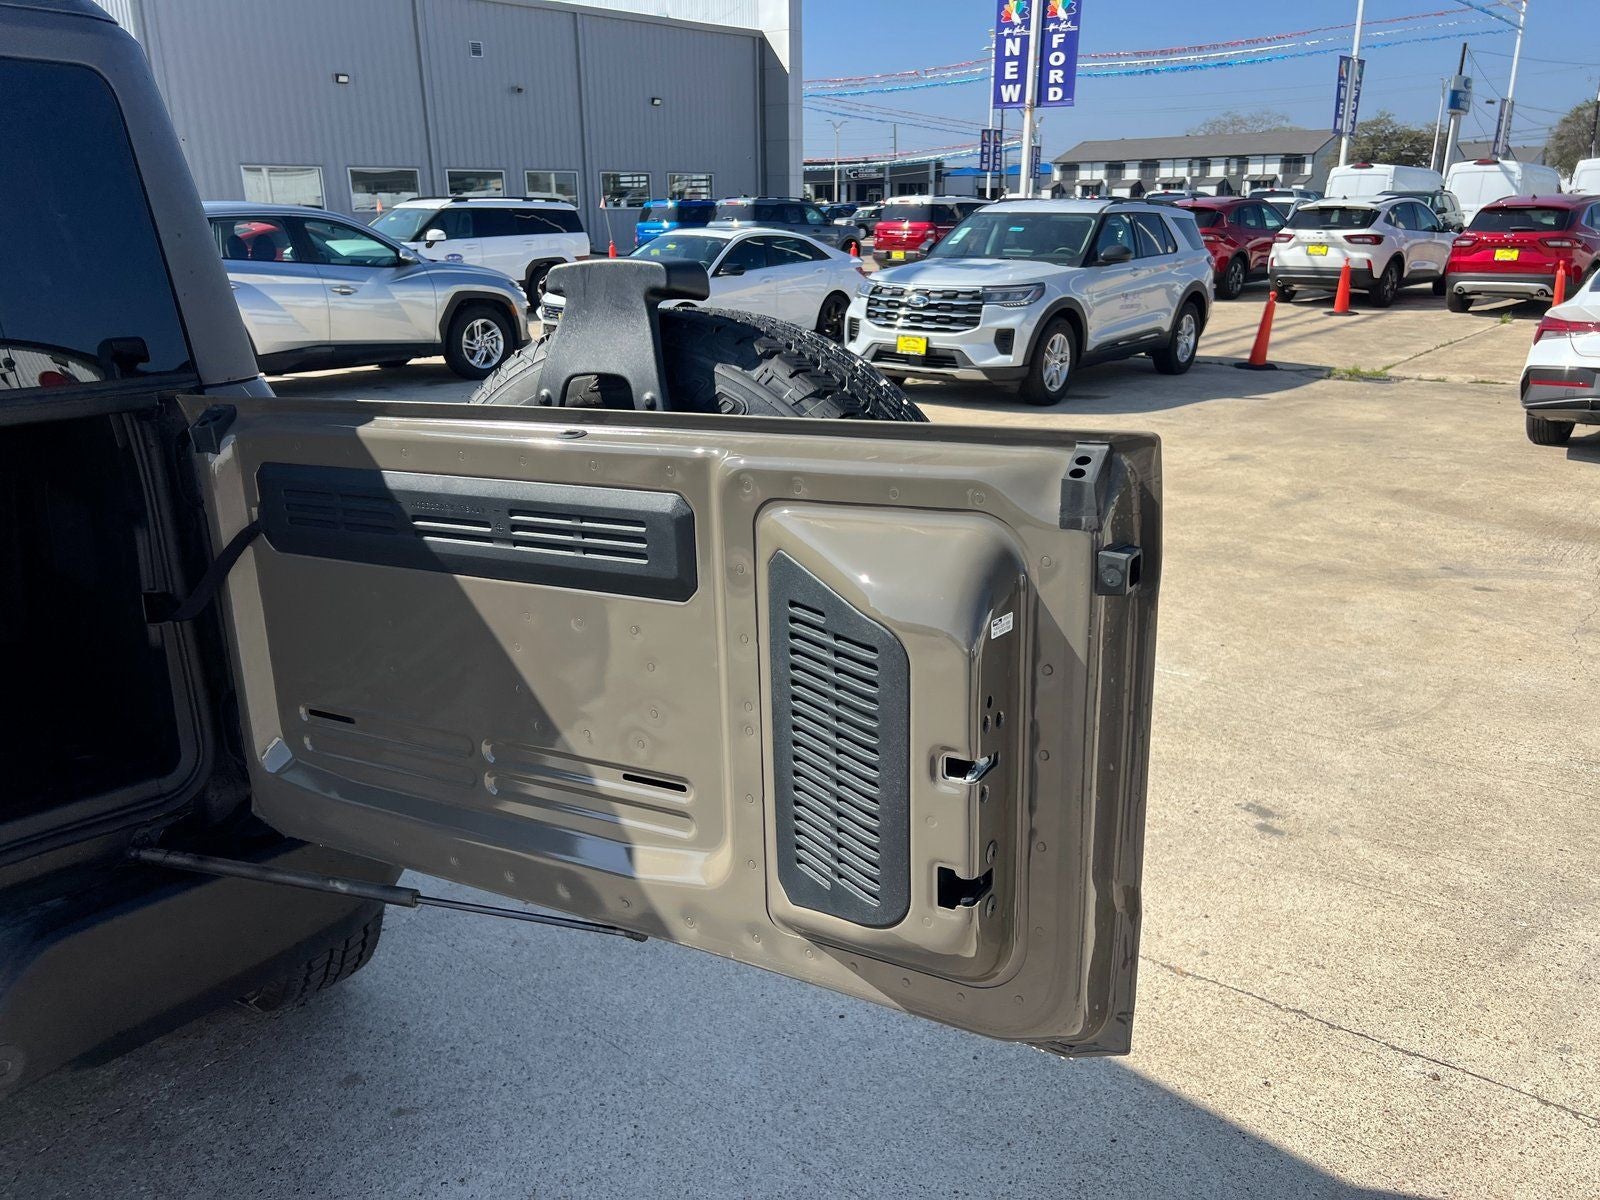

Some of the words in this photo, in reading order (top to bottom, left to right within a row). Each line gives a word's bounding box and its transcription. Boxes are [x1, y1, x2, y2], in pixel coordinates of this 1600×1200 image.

[1001, 38, 1021, 103] NEW
[1048, 34, 1065, 101] FORD
[1336, 87, 1346, 129] NEW
